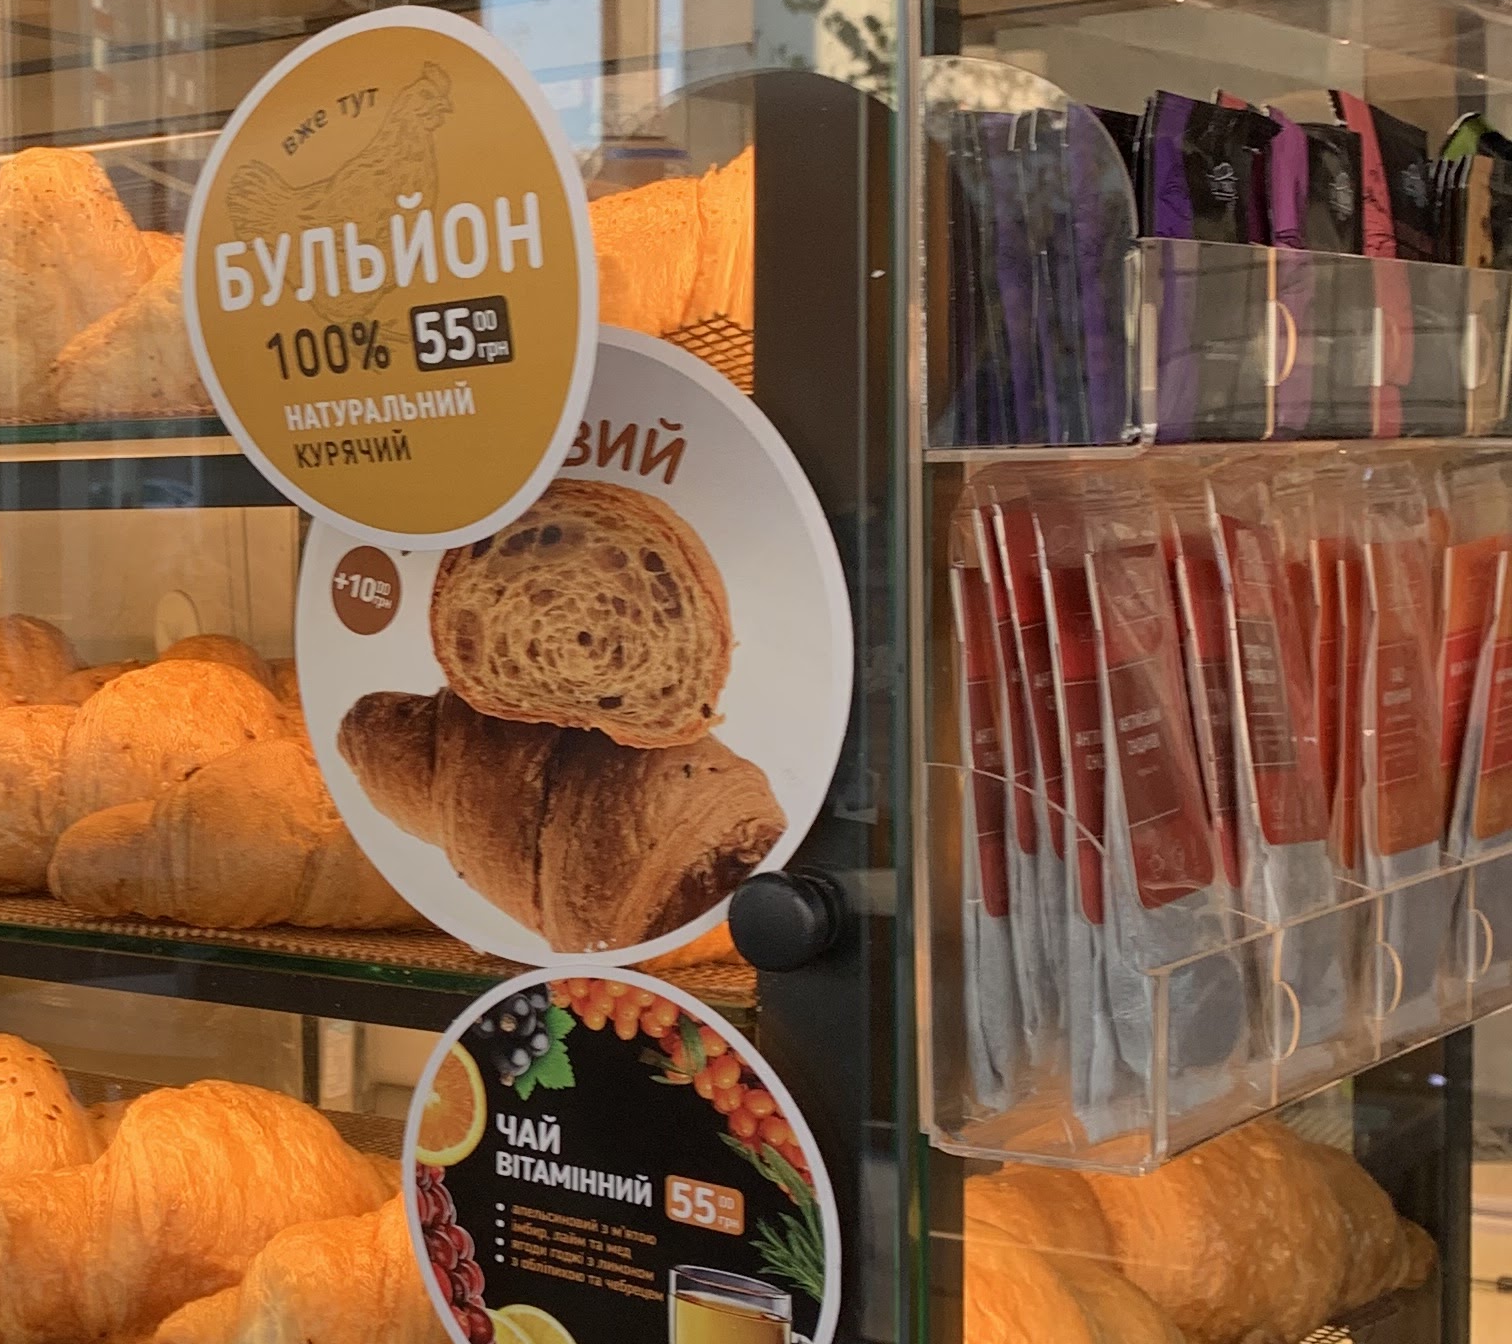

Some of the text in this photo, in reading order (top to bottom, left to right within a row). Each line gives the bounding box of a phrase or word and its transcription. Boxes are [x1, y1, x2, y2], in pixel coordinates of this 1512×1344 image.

[282, 86, 380, 156] вже тут
[213, 191, 544, 312] БУЛЬЙОН
[267, 307, 497, 380] 100% 55 00
[476, 340, 510, 363] грн
[284, 381, 477, 432] НАТУРАЛЬНИЙ
[293, 428, 412, 469] КУРЯЧИЙ
[333, 572, 377, 603] +10
[495, 1112, 561, 1155] ЧАЙ
[495, 1150, 653, 1208] ВІТАМІННИЙ
[671, 1181, 718, 1225] 55
[510, 1204, 599, 1233] апельсиновий
